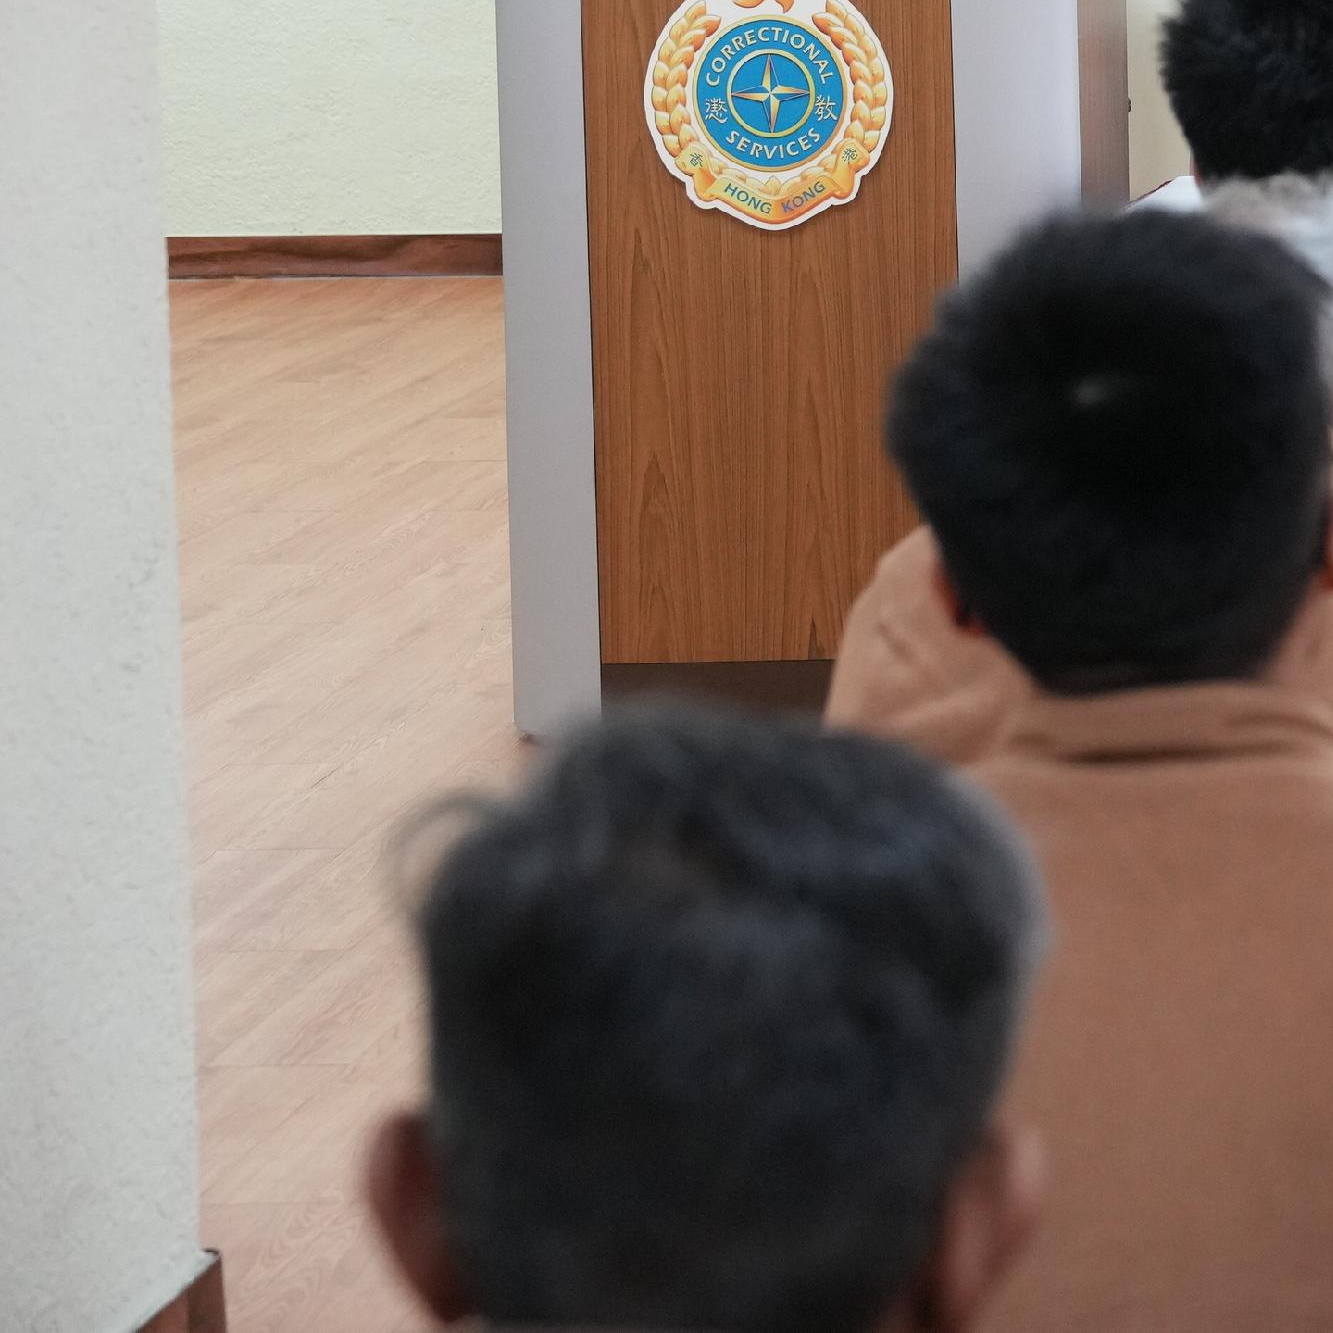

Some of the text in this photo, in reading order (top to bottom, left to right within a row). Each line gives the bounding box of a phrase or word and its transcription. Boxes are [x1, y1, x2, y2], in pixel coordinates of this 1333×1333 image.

[705, 26, 834, 87] CORRECTIONAL
[725, 127, 821, 159] SERVICES
[724, 181, 826, 214] HONG KONG
